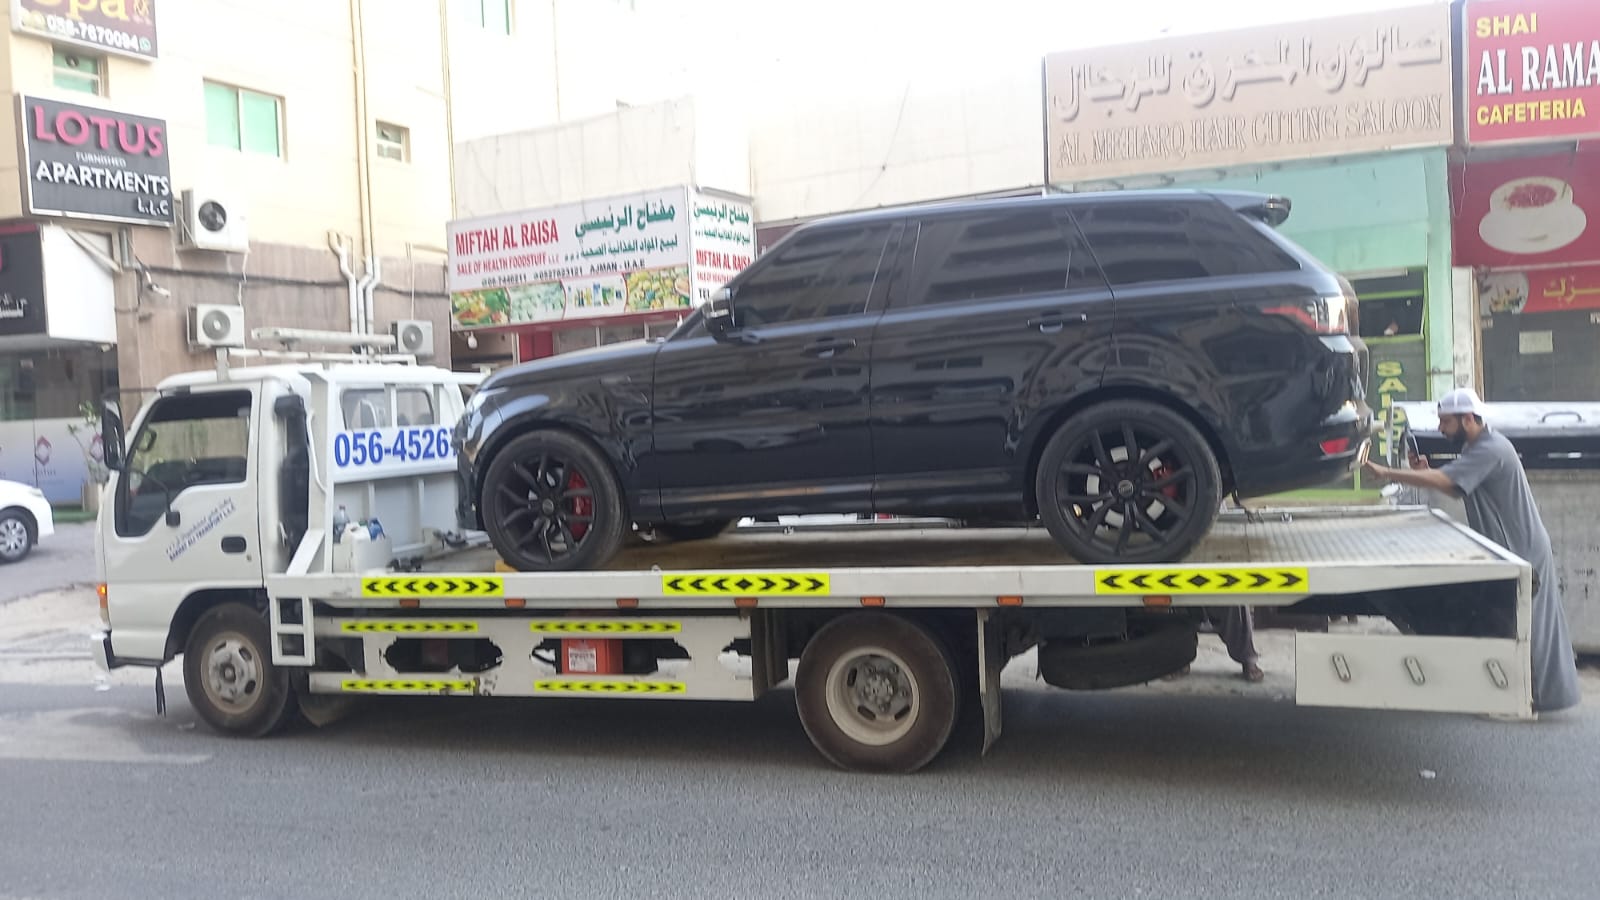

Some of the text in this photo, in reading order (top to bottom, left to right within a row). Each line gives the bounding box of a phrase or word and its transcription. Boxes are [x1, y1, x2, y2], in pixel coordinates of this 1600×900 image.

[34, 0, 129, 22] pa
[1476, 12, 1537, 38] SHAI
[1315, 24, 1443, 94] صالون
[1476, 48, 1513, 96] AL
[1053, 53, 1173, 122] للرجال
[1476, 98, 1586, 126] CAFETERIA
[34, 105, 164, 157] LOTUS
[1056, 131, 1087, 168] AL
[1190, 116, 1246, 152] HAIR
[1251, 105, 1339, 146] CUTING
[1345, 94, 1442, 138] SALOON
[36, 159, 170, 196] APARTMENTS
[75, 151, 127, 168] FURNISHED
[636, 199, 676, 230] مفتاح
[455, 216, 559, 256] MIFTAH AL RAISA
[457, 261, 472, 276] SALE
[473, 259, 481, 274] OF
[483, 256, 508, 272] HEALTH
[509, 251, 547, 269] FOODSTUFF
[696, 249, 721, 268] MIFTAH
[334, 428, 458, 468] 056-4526
